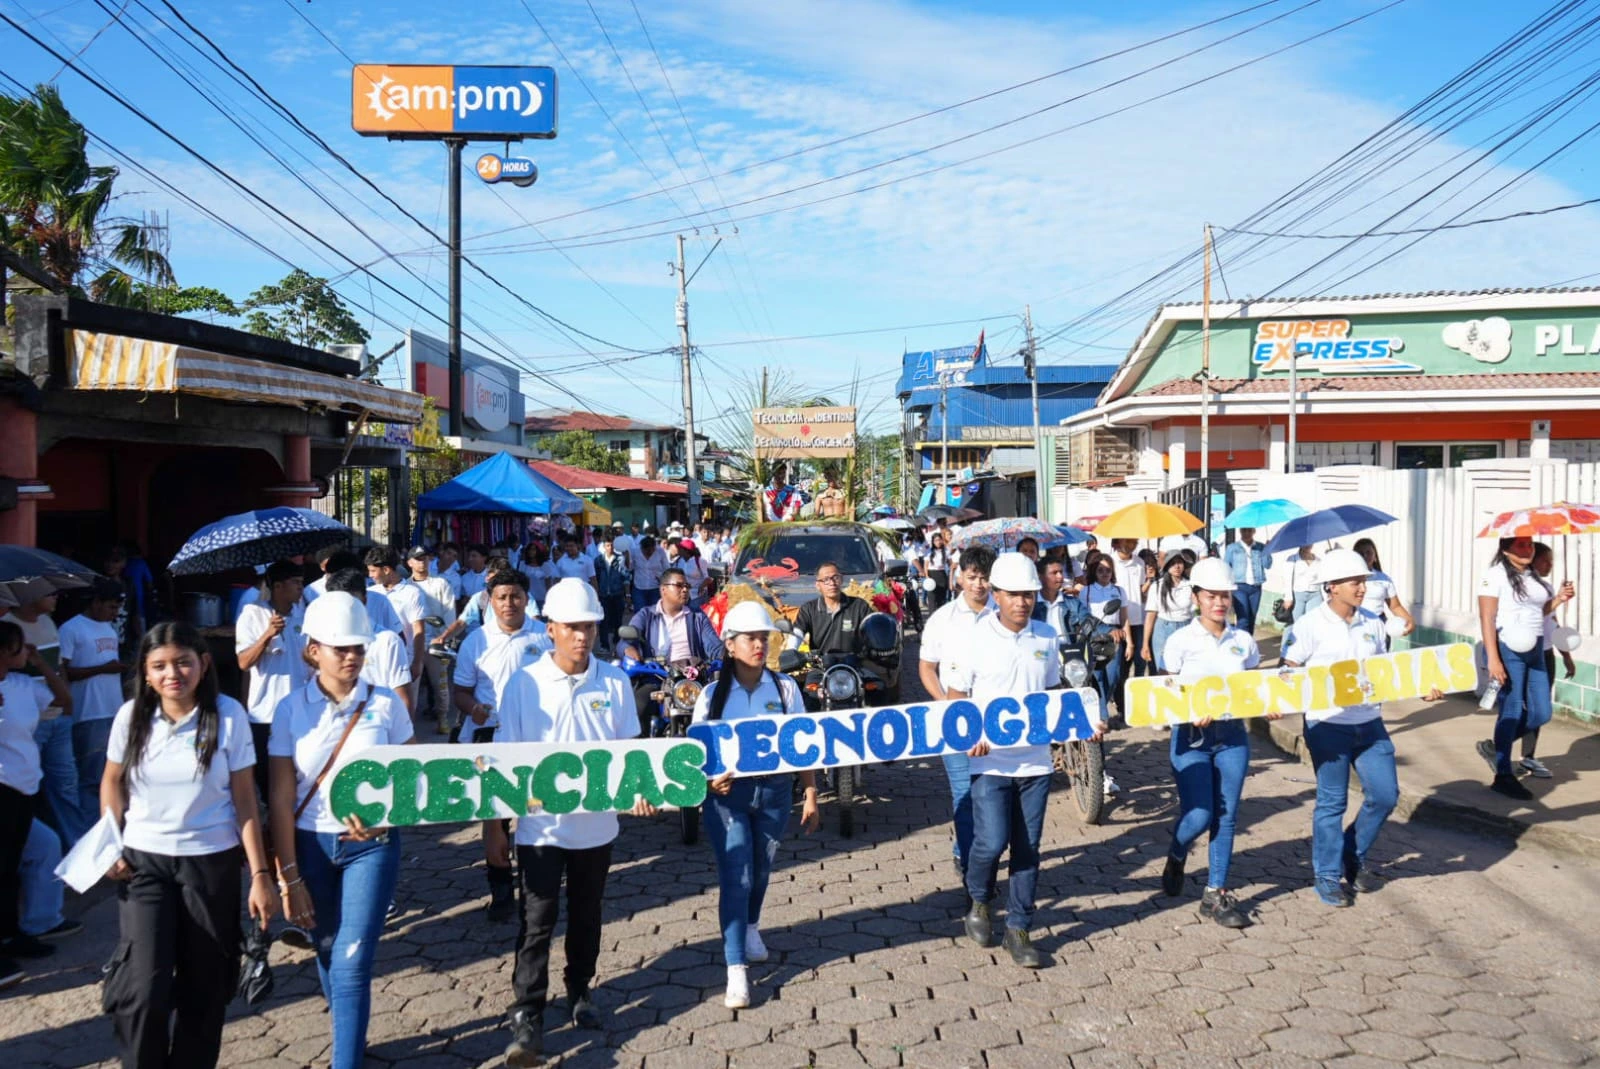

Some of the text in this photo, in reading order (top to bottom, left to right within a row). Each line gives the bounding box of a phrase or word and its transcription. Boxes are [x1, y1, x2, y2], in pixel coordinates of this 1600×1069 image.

[478, 159, 530, 174] 24 HORAS
[1254, 340, 1390, 368] EXPRESS
[1258, 320, 1349, 339] SUPER
[1129, 643, 1475, 727] INGENIERIAS
[686, 690, 1097, 776] TECNOLOGIA
[330, 743, 706, 827] CIENCIAS
